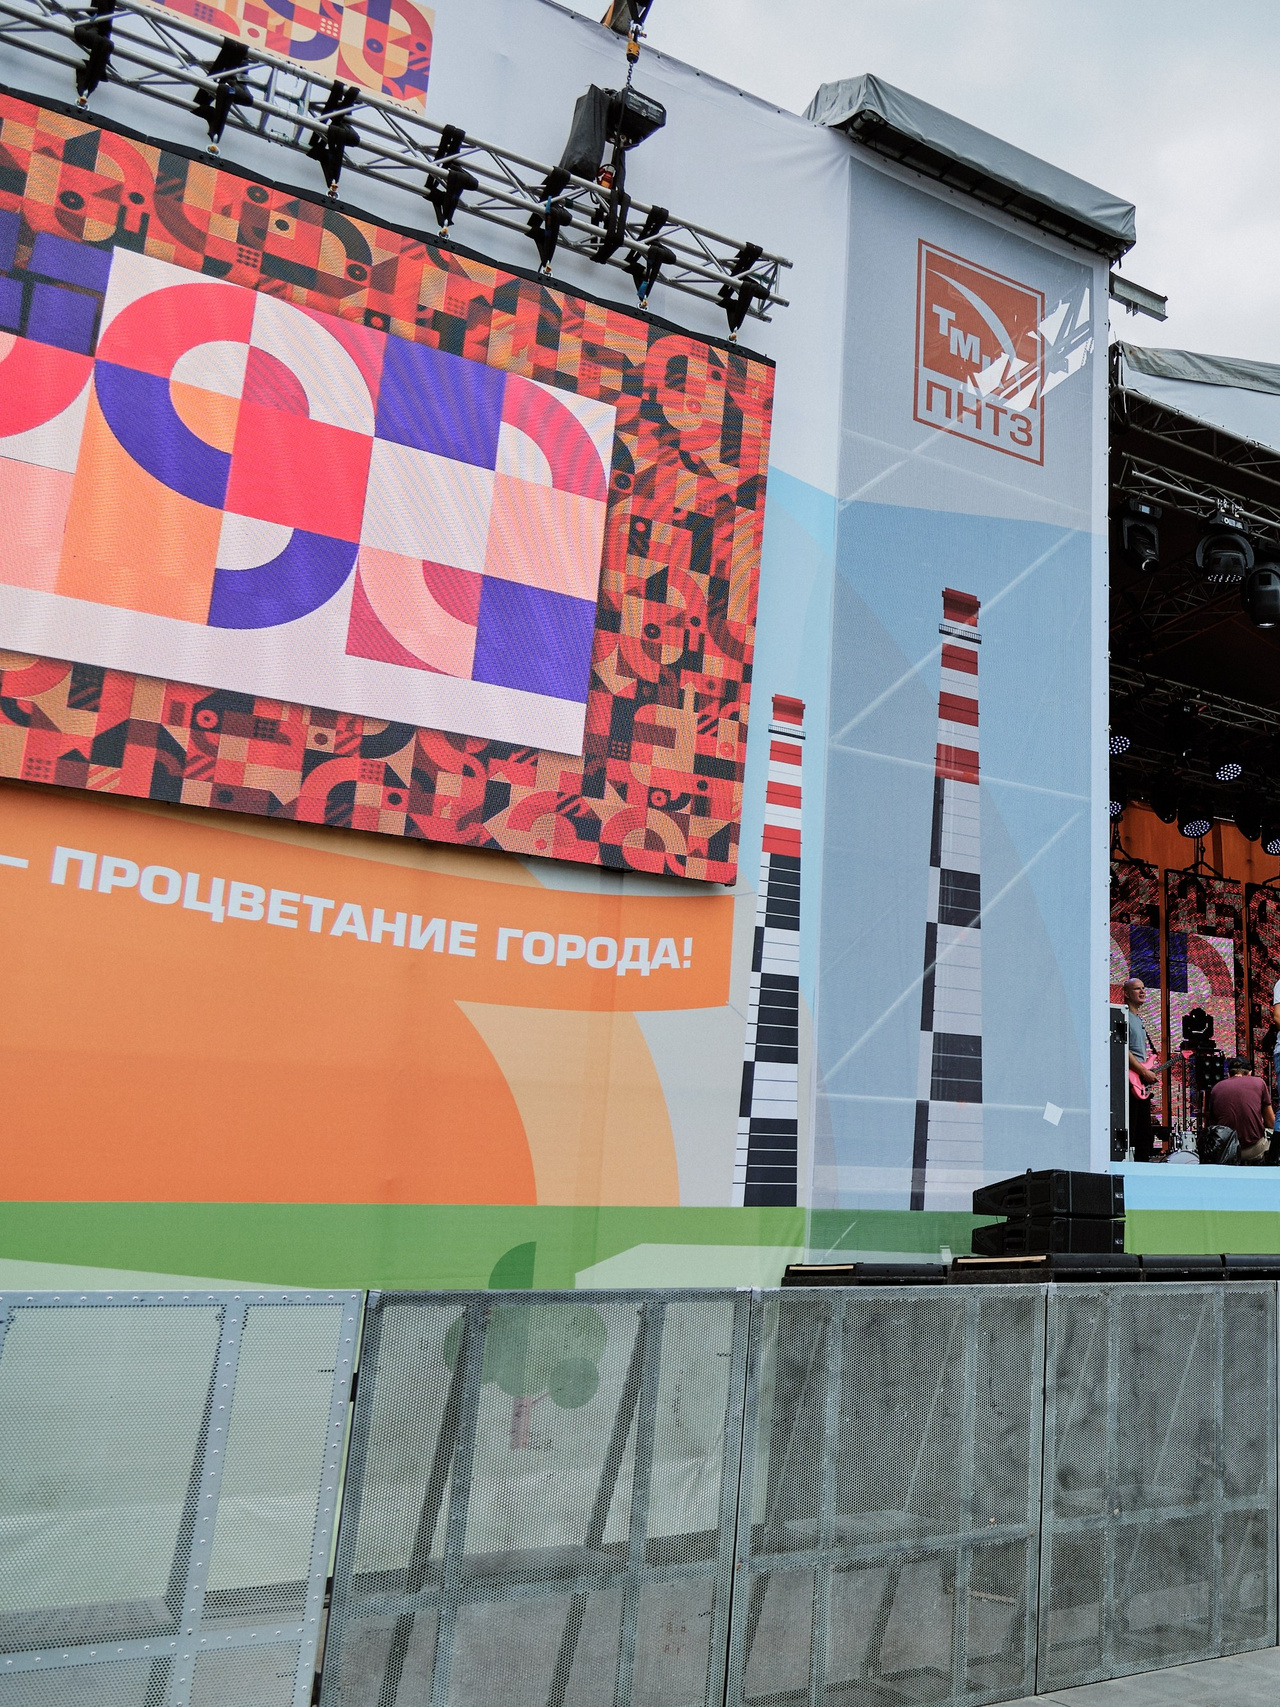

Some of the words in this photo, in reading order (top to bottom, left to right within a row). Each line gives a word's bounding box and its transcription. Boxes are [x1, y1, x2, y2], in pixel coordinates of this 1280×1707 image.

[932, 303, 998, 380] ТМ
[926, 379, 1033, 447] ПНТЗ
[50, 845, 479, 958] ПРОЦВЕТАНИЕ
[496, 926, 693, 976] ГОРОДА!
